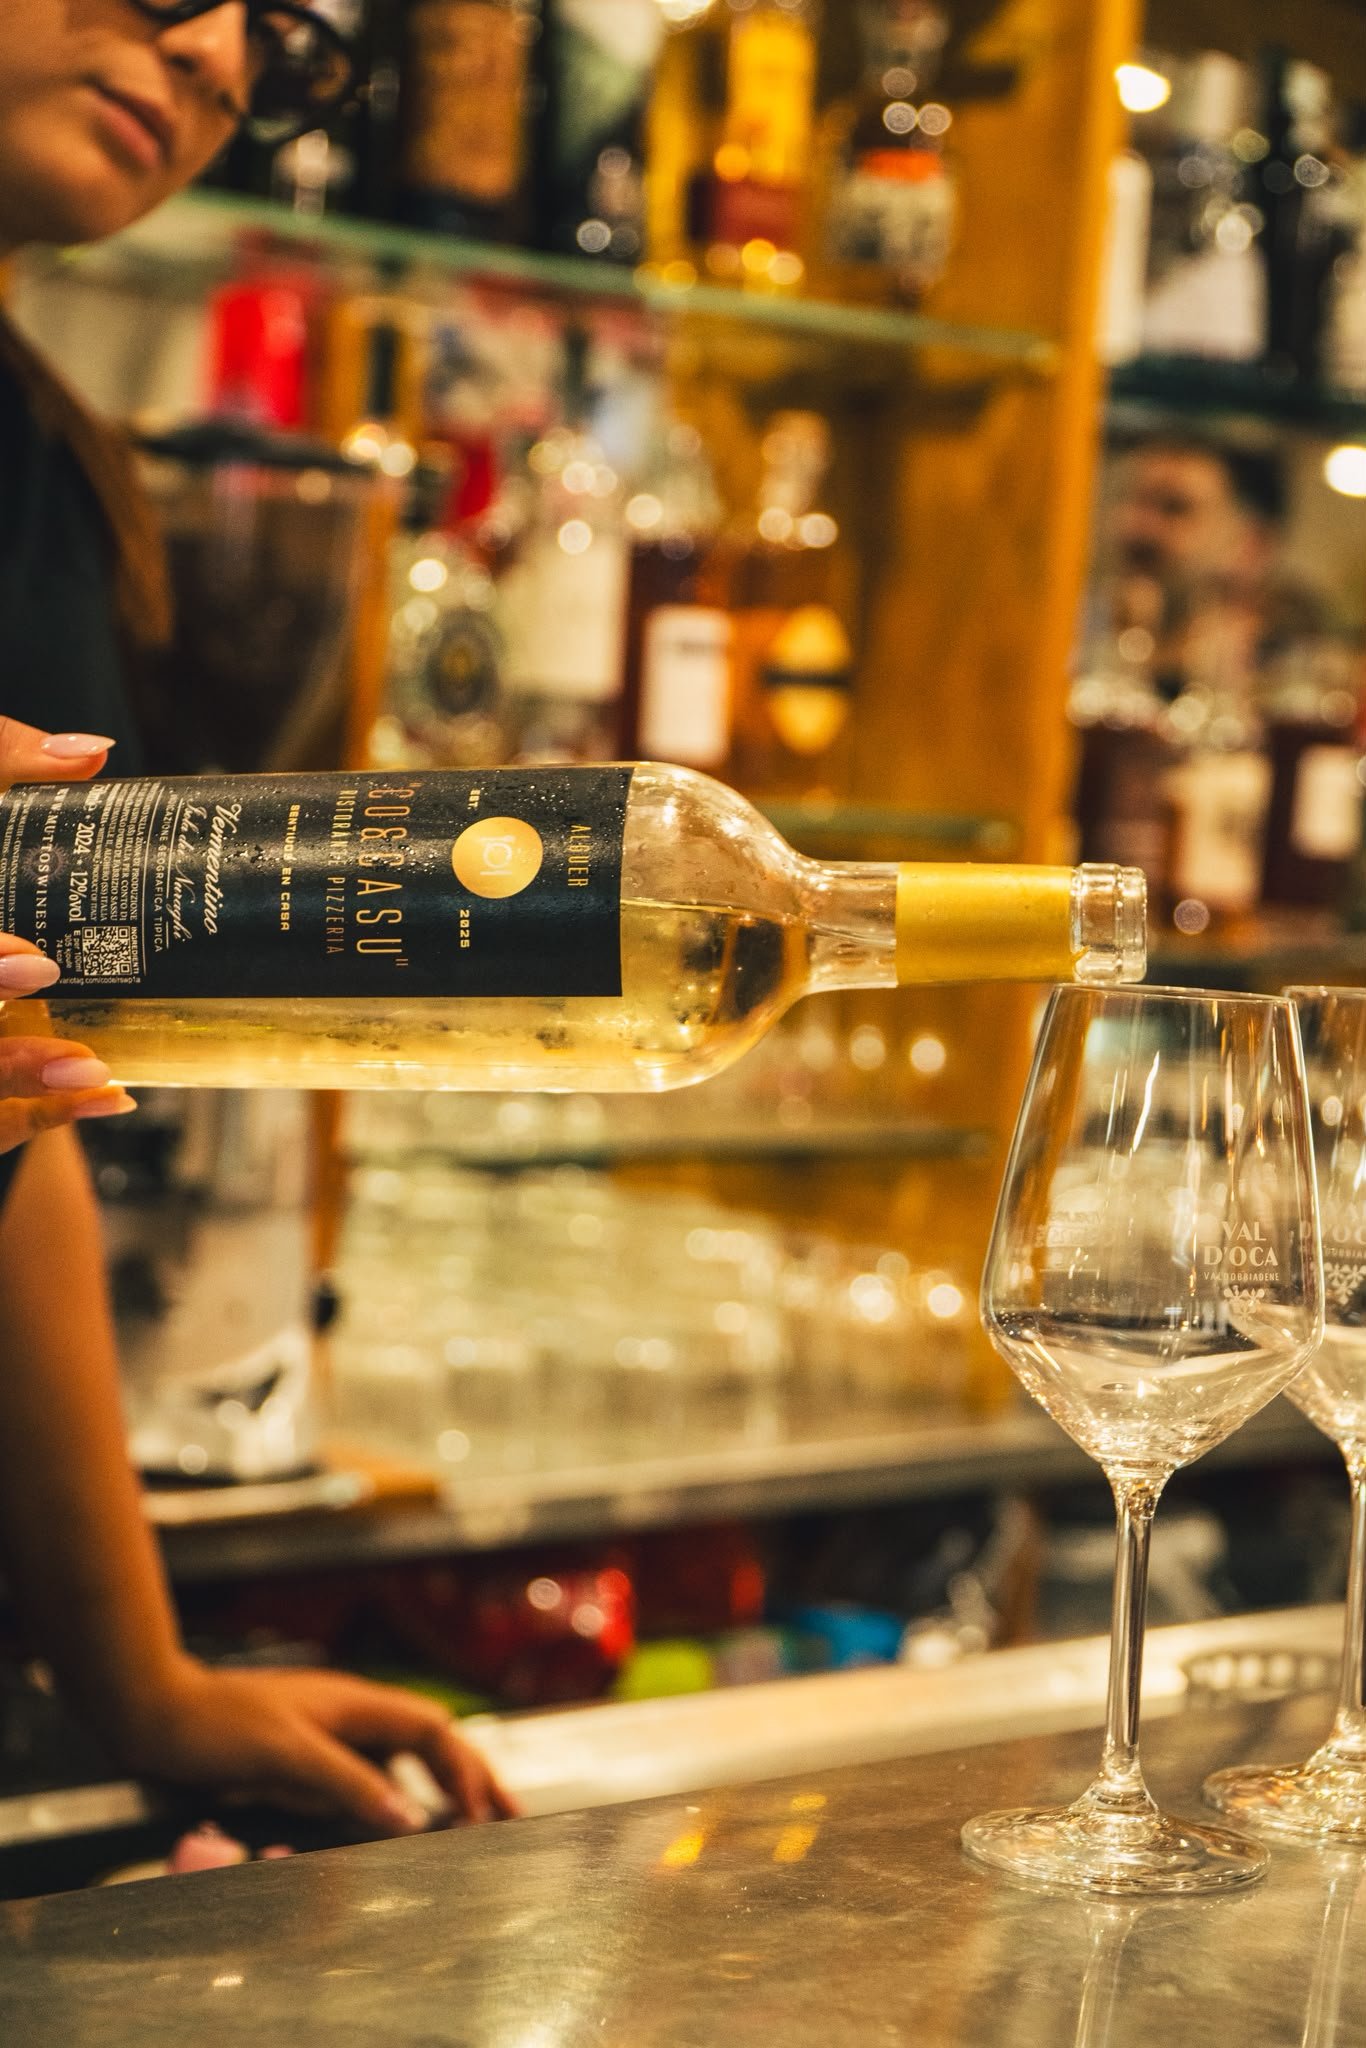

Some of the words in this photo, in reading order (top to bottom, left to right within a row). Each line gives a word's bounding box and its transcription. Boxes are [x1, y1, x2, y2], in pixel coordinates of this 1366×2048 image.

[180, 799, 207, 833] Isola
[327, 790, 357, 866] RISTORANTE
[73, 822, 96, 855] 2024
[124, 838, 133, 861] ITALIA
[567, 824, 591, 887] ALGUER
[101, 848, 112, 881] ALGHERO
[111, 859, 121, 895] FABRIZIO
[122, 863, 130, 878] PER
[154, 845, 167, 911] GEOGRAFICA
[203, 804, 242, 935] Vermentino
[281, 868, 291, 885] EN
[68, 871, 88, 922] 12%vol
[110, 896, 118, 920] SASSU
[120, 880, 128, 909] CONTO
[130, 868, 139, 920] PRODUZIONE
[166, 860, 194, 942] Nuraghi
[281, 893, 290, 931] CASA
[326, 877, 345, 954] PIZZERIA
[460, 909, 470, 948] 2025
[56, 940, 62, 948] 74
[131, 927, 139, 974] INGREDIENTI
[154, 916, 163, 952] TIPICA
[1222, 1221, 1266, 1241] VAL
[1204, 1246, 1278, 1266] D'OCA
[1204, 1272, 1279, 1281] VALDOBBIADENE
